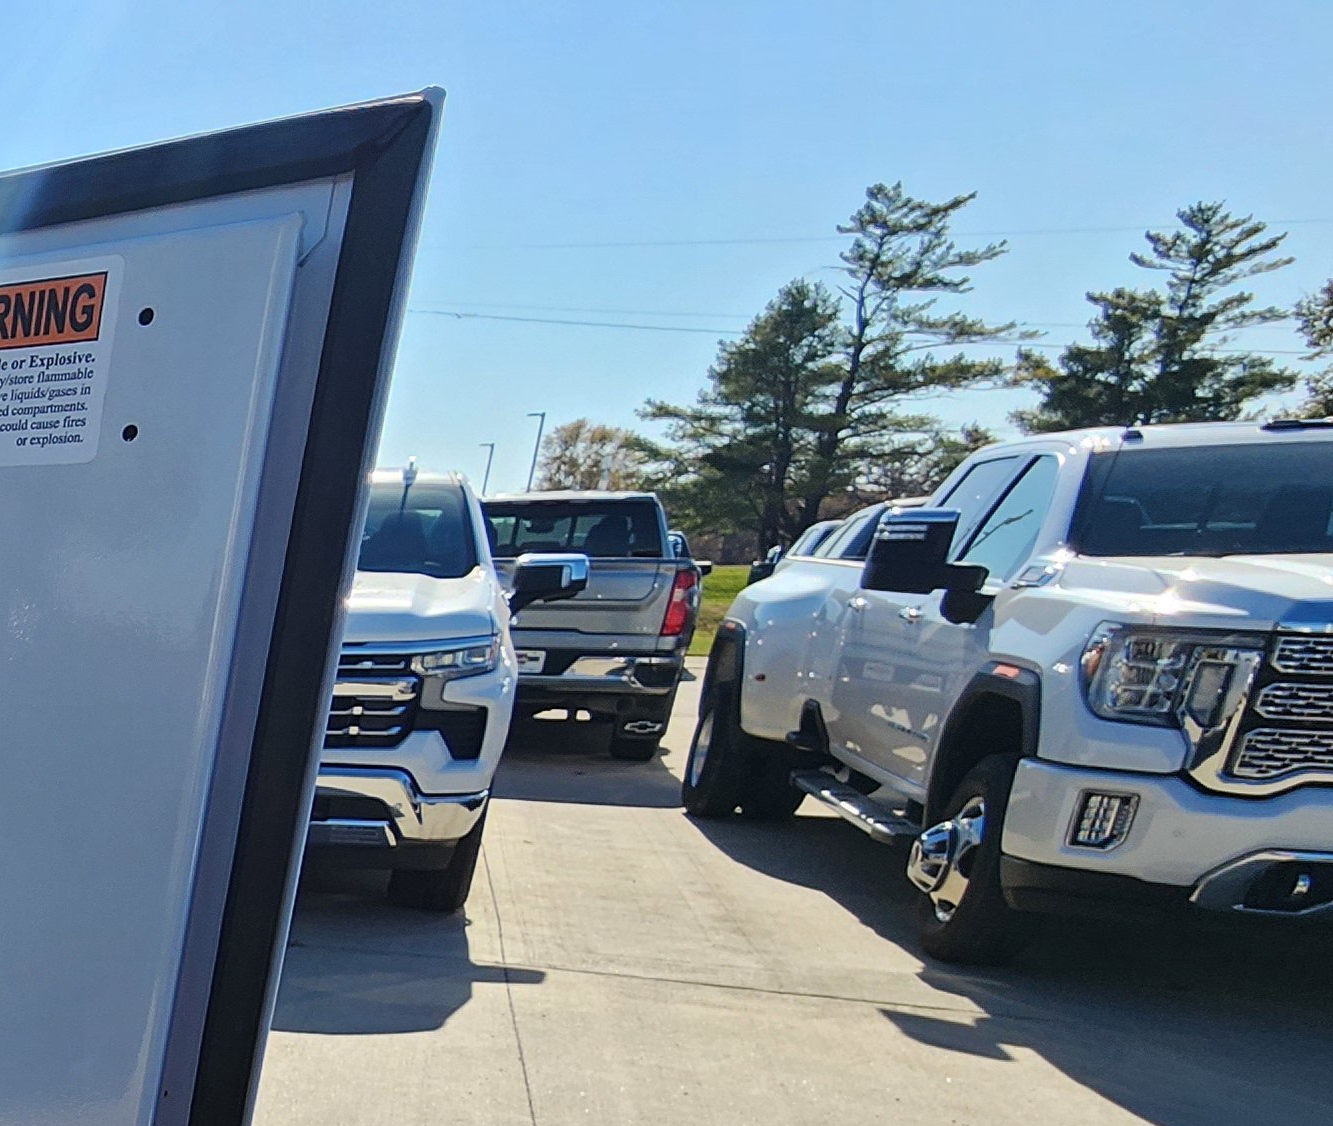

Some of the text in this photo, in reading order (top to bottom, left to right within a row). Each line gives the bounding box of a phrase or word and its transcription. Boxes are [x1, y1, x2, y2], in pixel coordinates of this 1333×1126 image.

[11, 360, 25, 370] or
[28, 351, 96, 370] Explosive.
[37, 368, 94, 383] flammable
[10, 385, 77, 403] liquids/gases
[80, 384, 91, 396] in
[11, 401, 88, 418] compartments.
[0, 419, 28, 432] could
[30, 419, 60, 430] cause
[63, 416, 86, 428] fires
[16, 432, 84, 447] or explosion.
